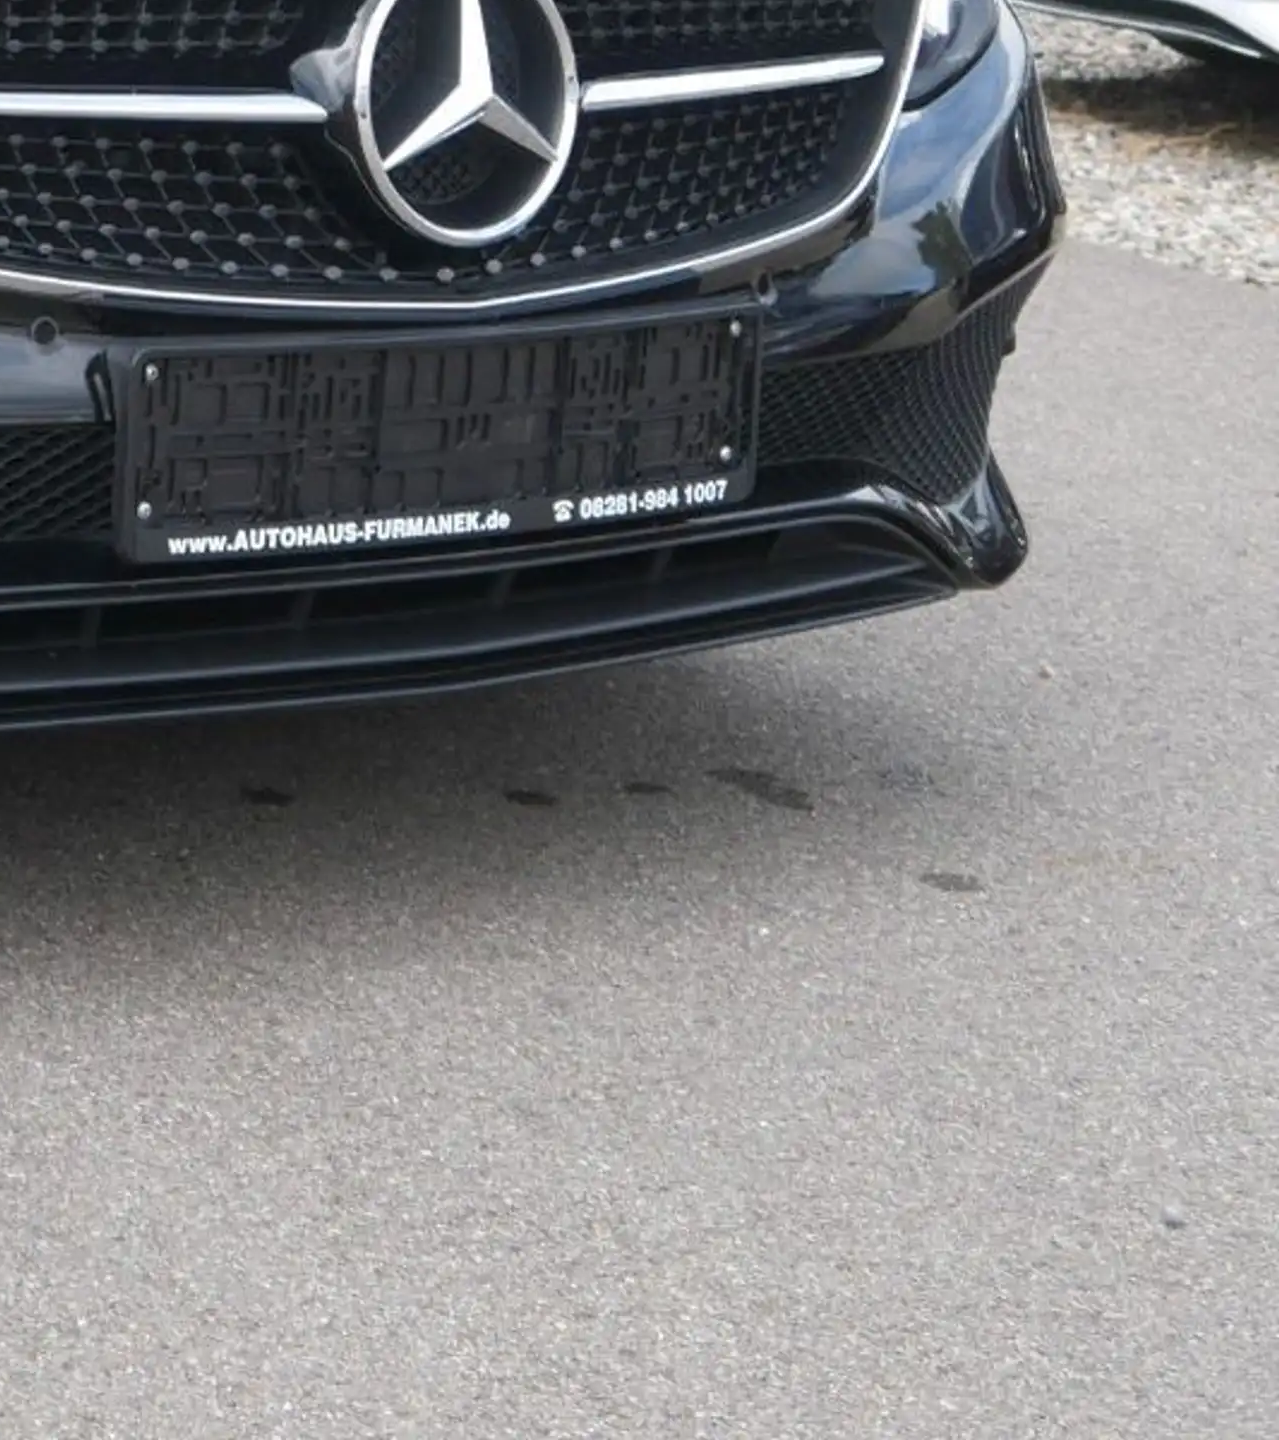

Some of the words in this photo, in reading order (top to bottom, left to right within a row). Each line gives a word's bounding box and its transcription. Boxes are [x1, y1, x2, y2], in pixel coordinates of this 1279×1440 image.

[167, 509, 511, 554] www.AUTOHAUS-FURMANEK.de
[578, 486, 679, 519] 08281-984
[683, 478, 728, 503] 1007
